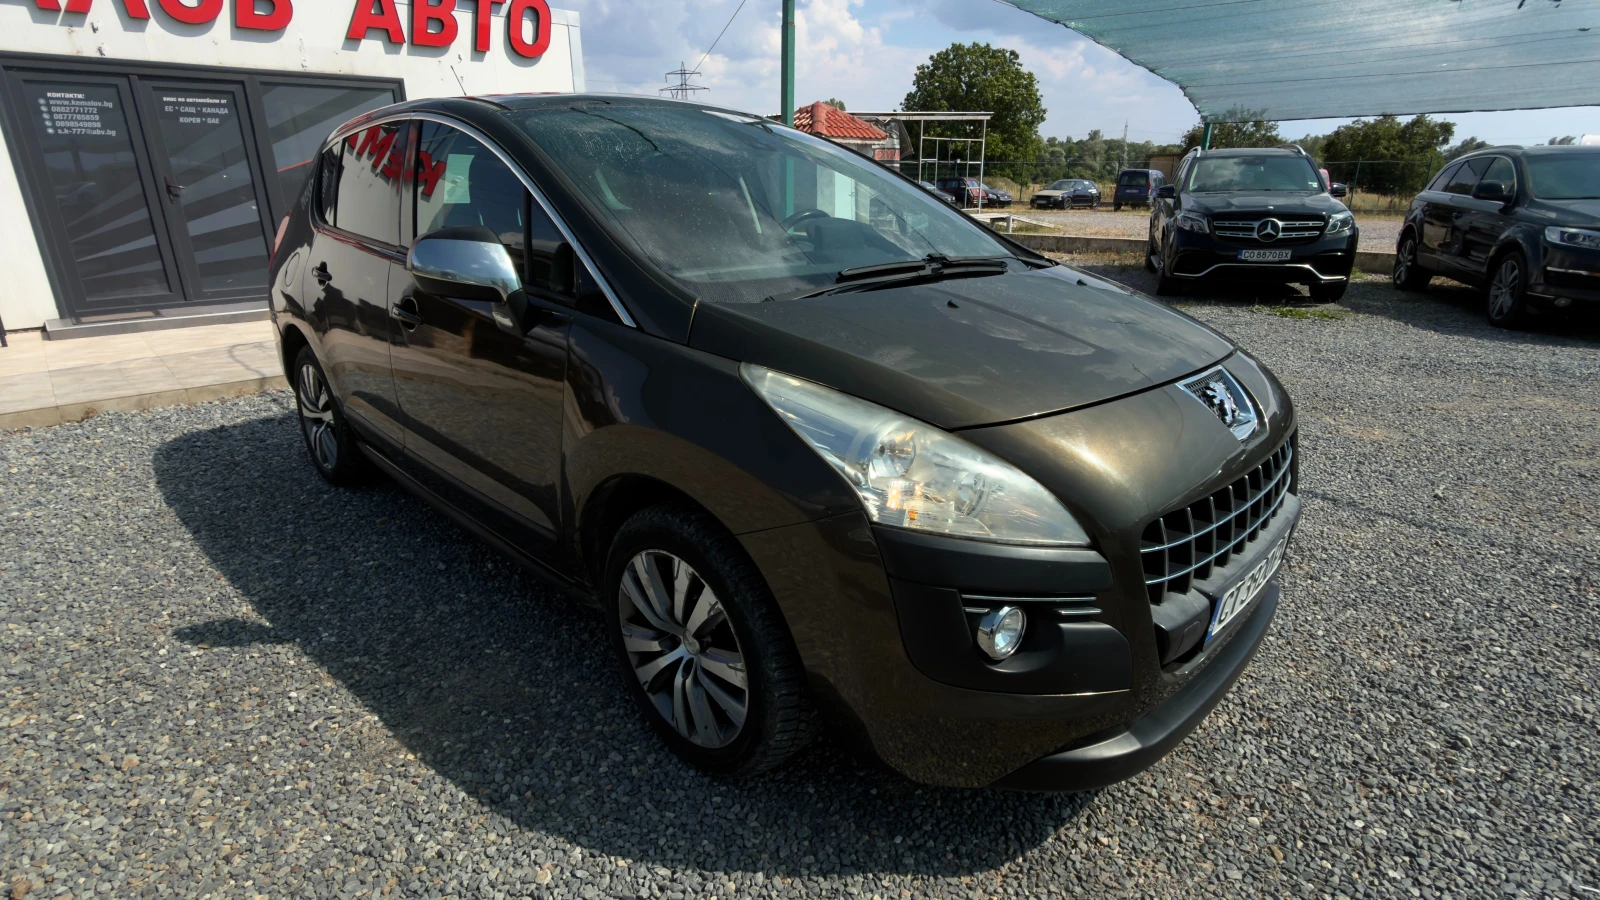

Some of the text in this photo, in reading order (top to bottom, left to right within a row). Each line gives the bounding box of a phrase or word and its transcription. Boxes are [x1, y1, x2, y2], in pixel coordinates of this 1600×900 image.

[347, 0, 551, 58] АВТО
[49, 99, 113, 108] www.kemalov.bg
[51, 106, 98, 114] 0882771772
[53, 113, 100, 121] 0877785859
